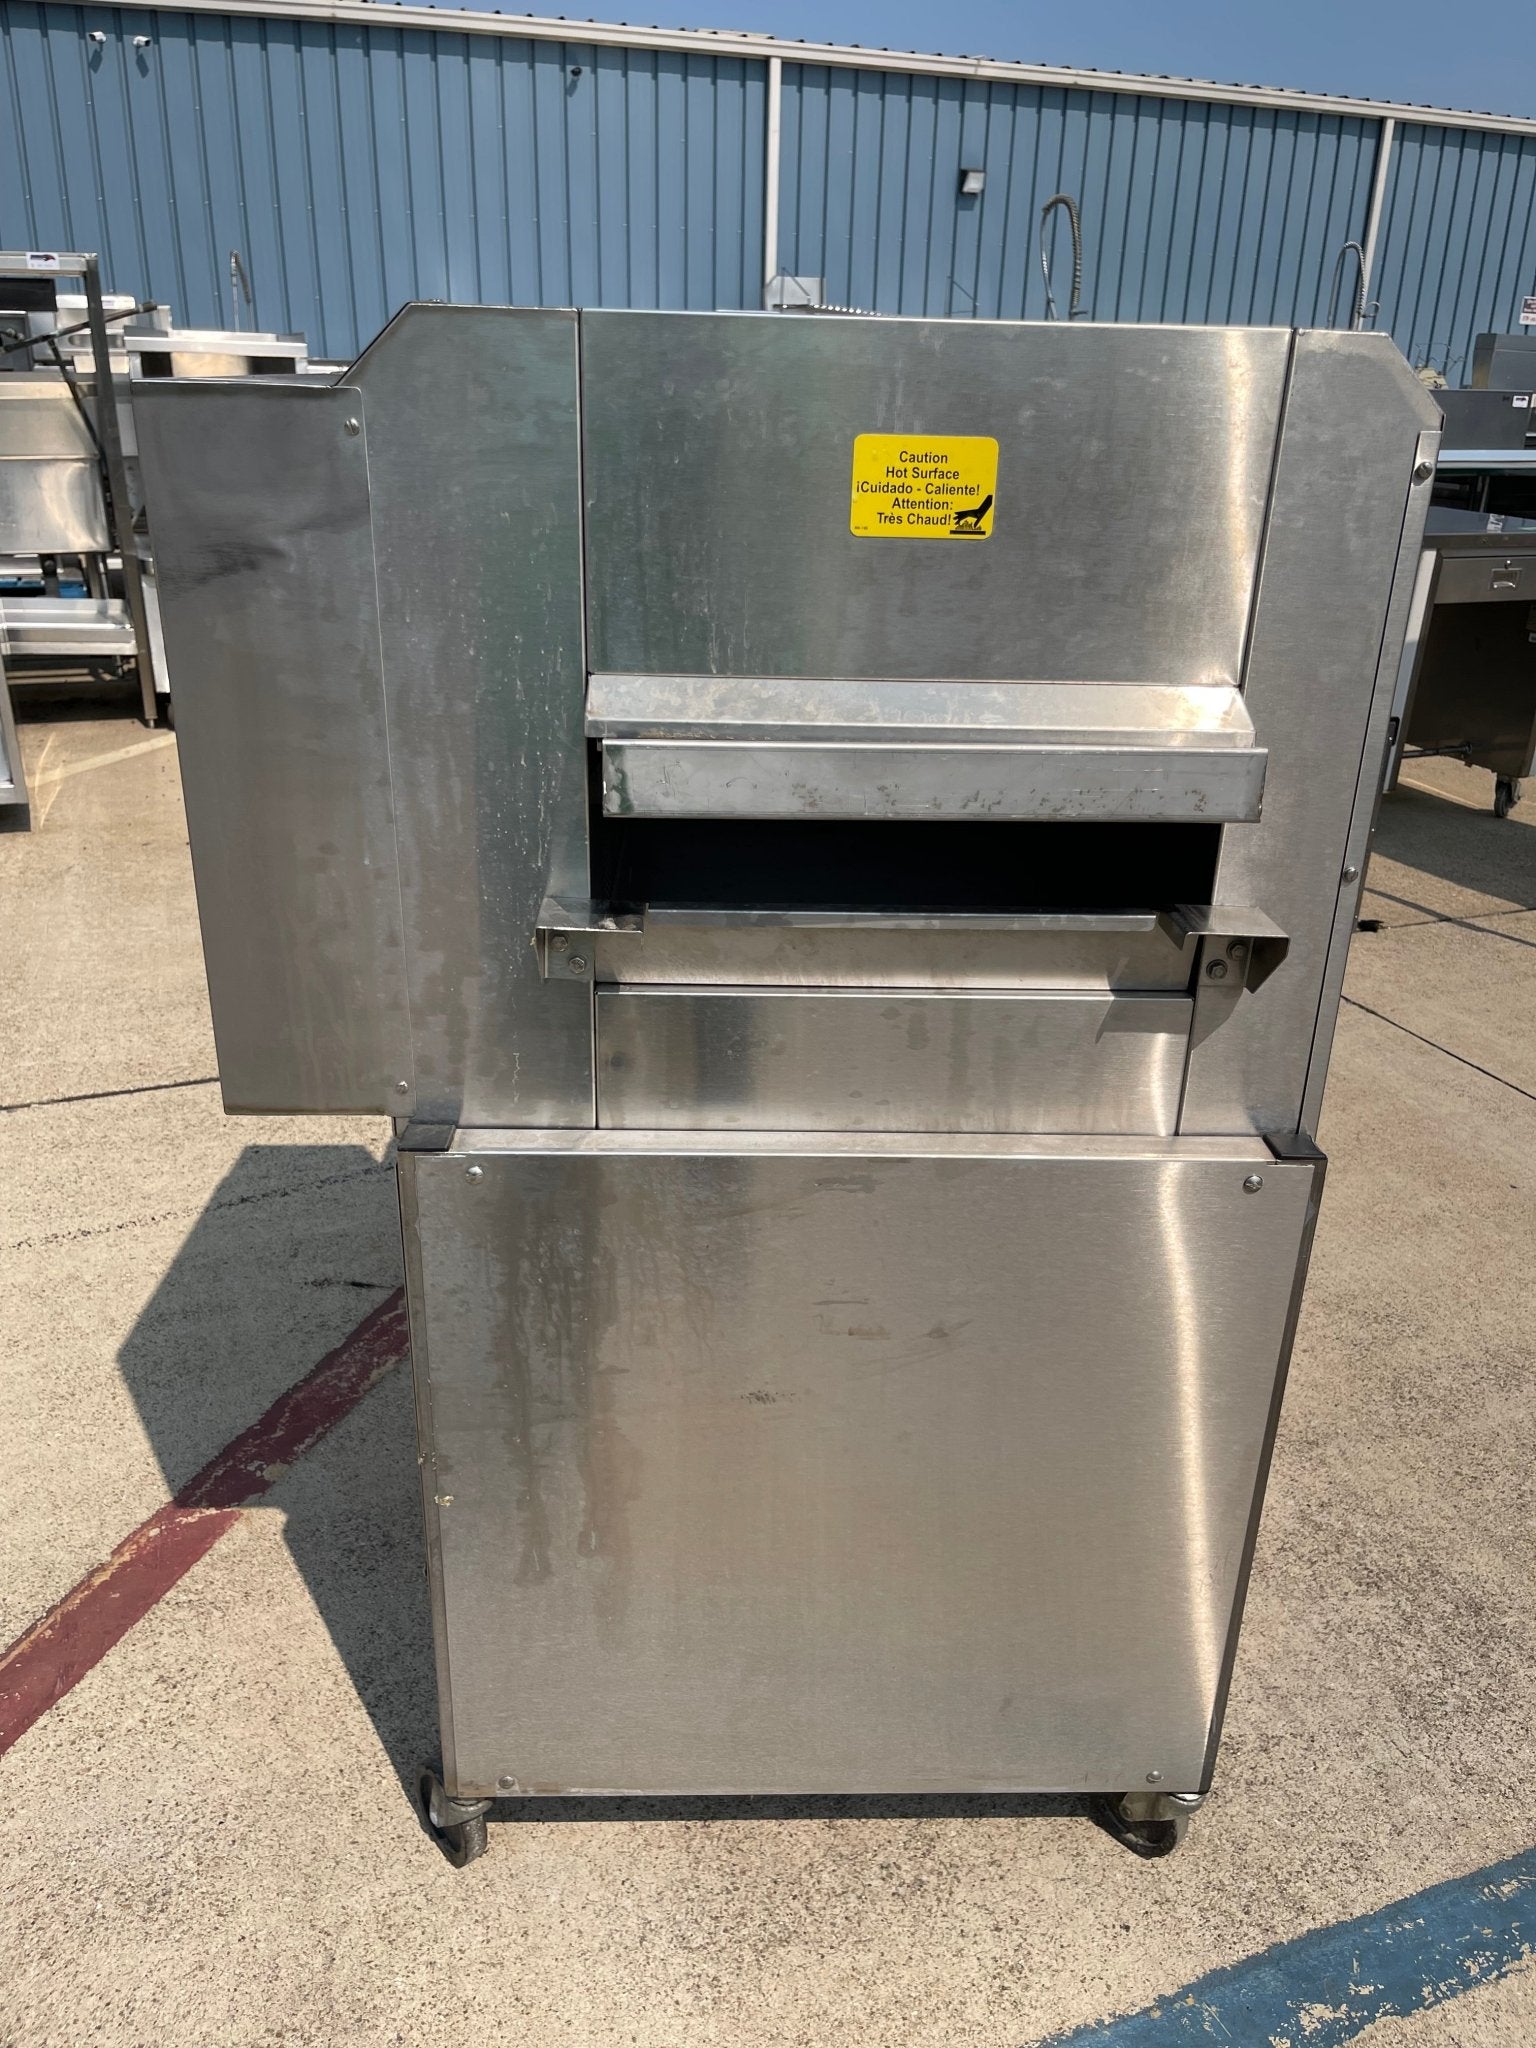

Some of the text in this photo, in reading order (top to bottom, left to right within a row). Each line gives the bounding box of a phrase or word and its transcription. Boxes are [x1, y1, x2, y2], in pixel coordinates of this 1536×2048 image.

[899, 451, 948, 464] Caution
[886, 466, 960, 480] Hot Surface
[925, 483, 980, 496] Caliente!
[891, 497, 953, 510] Attention:
[877, 512, 951, 526] Très Chaud!
